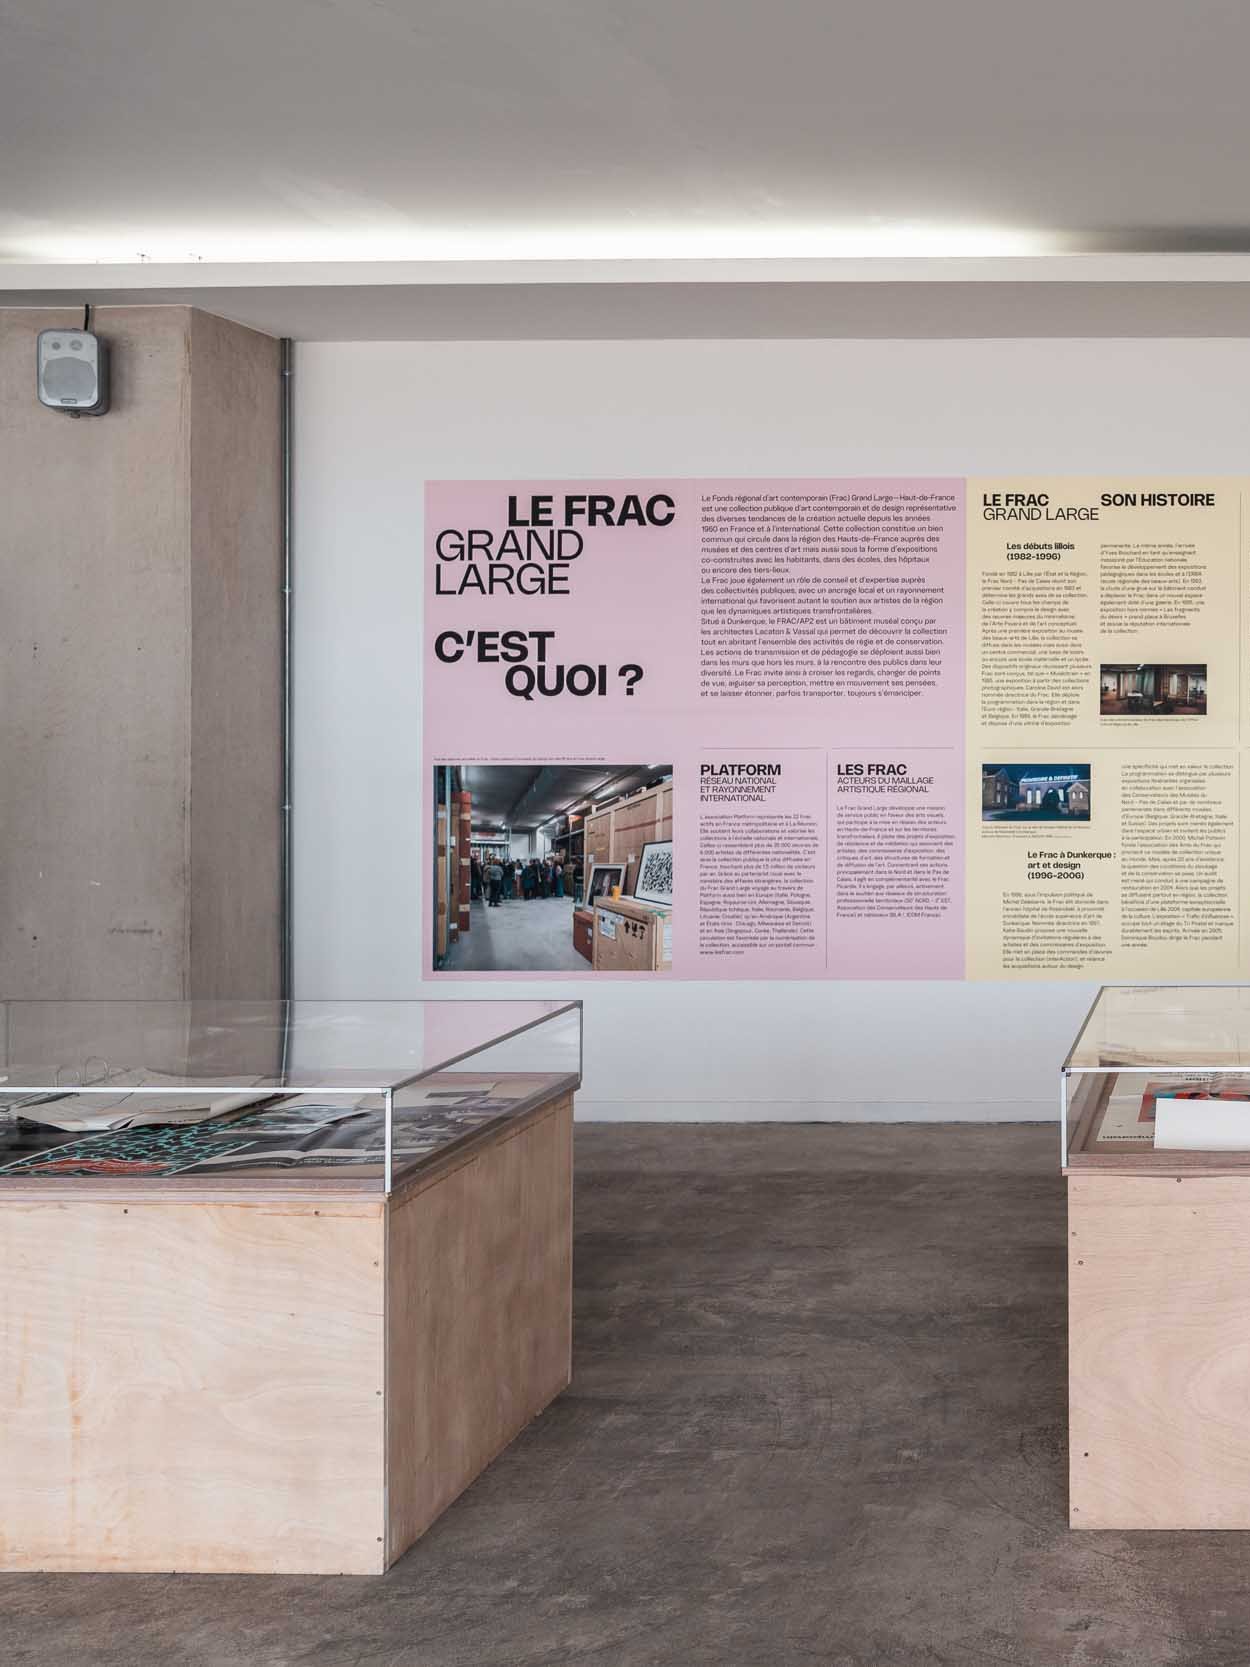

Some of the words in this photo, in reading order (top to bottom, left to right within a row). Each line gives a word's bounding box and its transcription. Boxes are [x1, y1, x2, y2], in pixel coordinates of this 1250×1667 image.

[983, 493, 1002, 507] LE
[1005, 493, 1050, 507] FRAC
[1100, 493, 1137, 507] SON
[1140, 493, 1216, 507] HISTOIRE
[508, 495, 554, 528] LE
[564, 493, 676, 527] FRAC
[983, 507, 1042, 521] GRAND
[1045, 507, 1100, 521] LARGE
[435, 528, 584, 562] GRAND
[1006, 542, 1022, 550] Les
[1022, 542, 1054, 551] débuts
[1054, 542, 1076, 550] lillois
[435, 562, 571, 596] LARGE
[434, 629, 556, 664] C'EST
[504, 663, 607, 701] QUOI
[617, 663, 644, 697] ?
[700, 763, 782, 776] PLATFORM
[837, 763, 864, 776] LES
[867, 763, 908, 776] FRAC
[699, 775, 734, 785] RÉSEAU
[734, 776, 777, 785] NATIONAL
[836, 776, 877, 785] ACTEURS
[877, 776, 891, 785] DU
[891, 776, 935, 785] MAILLAGE
[700, 785, 711, 794] ET
[711, 785, 777, 794] RAYONNEMENT
[836, 785, 886, 794] ARTISTIQUE
[886, 784, 929, 793] RÉGIONAL
[699, 794, 767, 803] INTERNATIONAL
[1027, 850, 1038, 859] Le
[1039, 850, 1059, 859] Frac
[1066, 850, 1113, 861] Dunkerque
[1027, 861, 1041, 869] art
[1041, 861, 1052, 869] et
[1052, 861, 1081, 871] design
